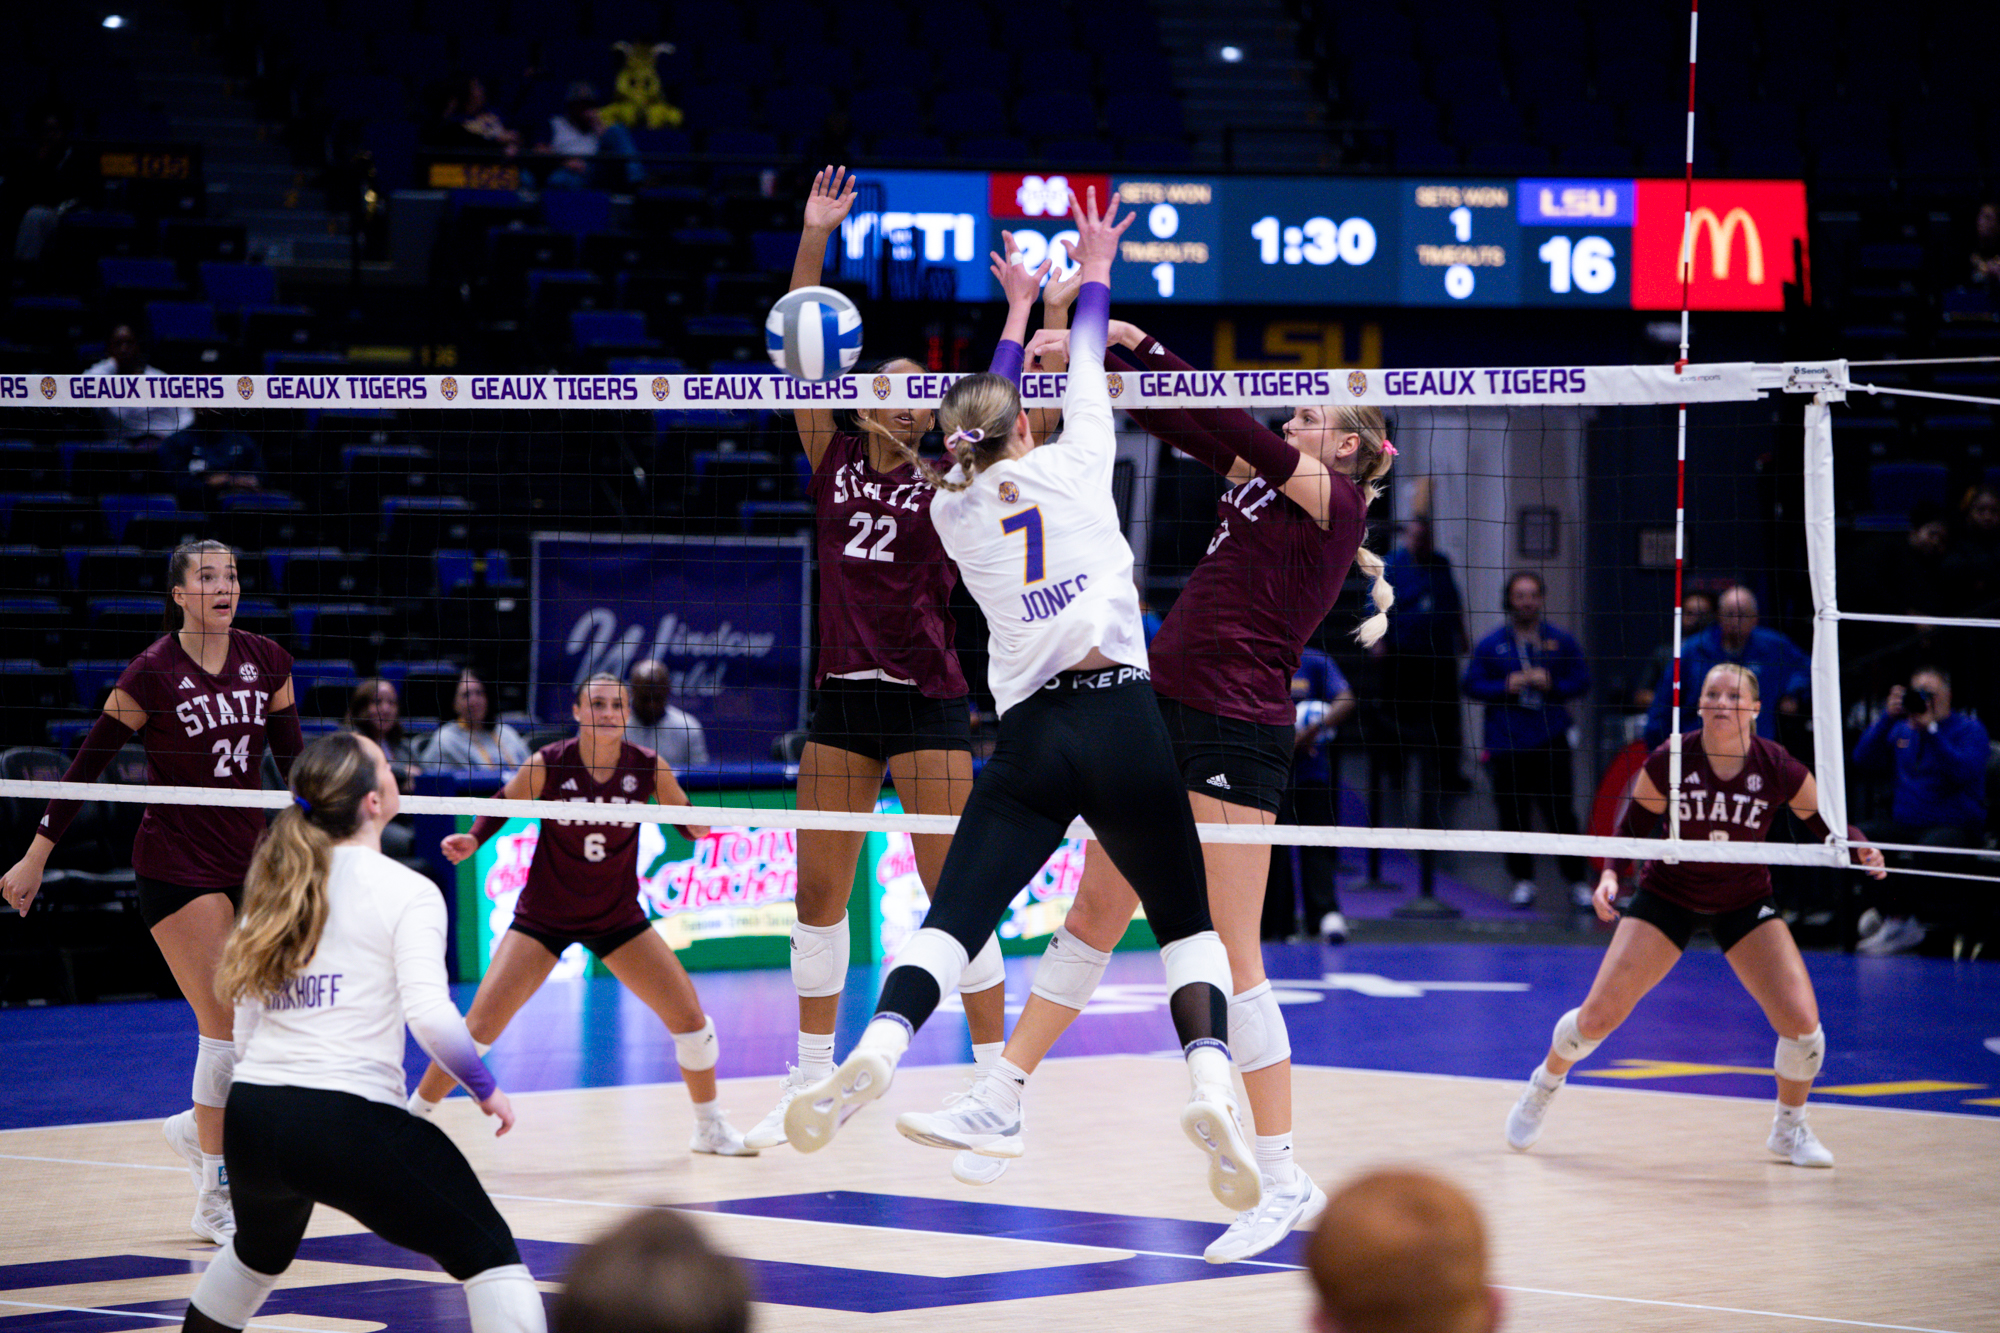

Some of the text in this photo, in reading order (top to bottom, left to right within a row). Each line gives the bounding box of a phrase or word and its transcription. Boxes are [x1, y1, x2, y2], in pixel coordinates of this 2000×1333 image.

[1148, 203, 1179, 239] 0
[1539, 188, 1617, 218] LSU
[841, 212, 976, 262] YETI
[1251, 216, 1377, 265] 1:30
[1449, 206, 1473, 243] 1
[1151, 261, 1175, 297] 1
[1444, 263, 1475, 300] 0
[1538, 235, 1617, 294] 16
[1214, 320, 1383, 370] LSU
[69, 376, 225, 399] GEAUX TIGERS
[266, 376, 427, 399] GEAUX TIGERS
[471, 377, 638, 400] GEAUX TIGERS
[684, 376, 858, 400] GEAUX TIGERS
[906, 374, 1068, 399] GEA GER
[1140, 371, 1330, 397] GEAUX TIGERS
[1384, 368, 1586, 396] GEAUX TIGERS
[1801, 367, 1829, 375] Senoh
[843, 511, 897, 562] 22
[1000, 504, 1046, 586] 7
[176, 690, 269, 738] STATE
[212, 735, 250, 778] 24
[1678, 790, 1768, 829] STATE
[584, 833, 606, 862] 6
